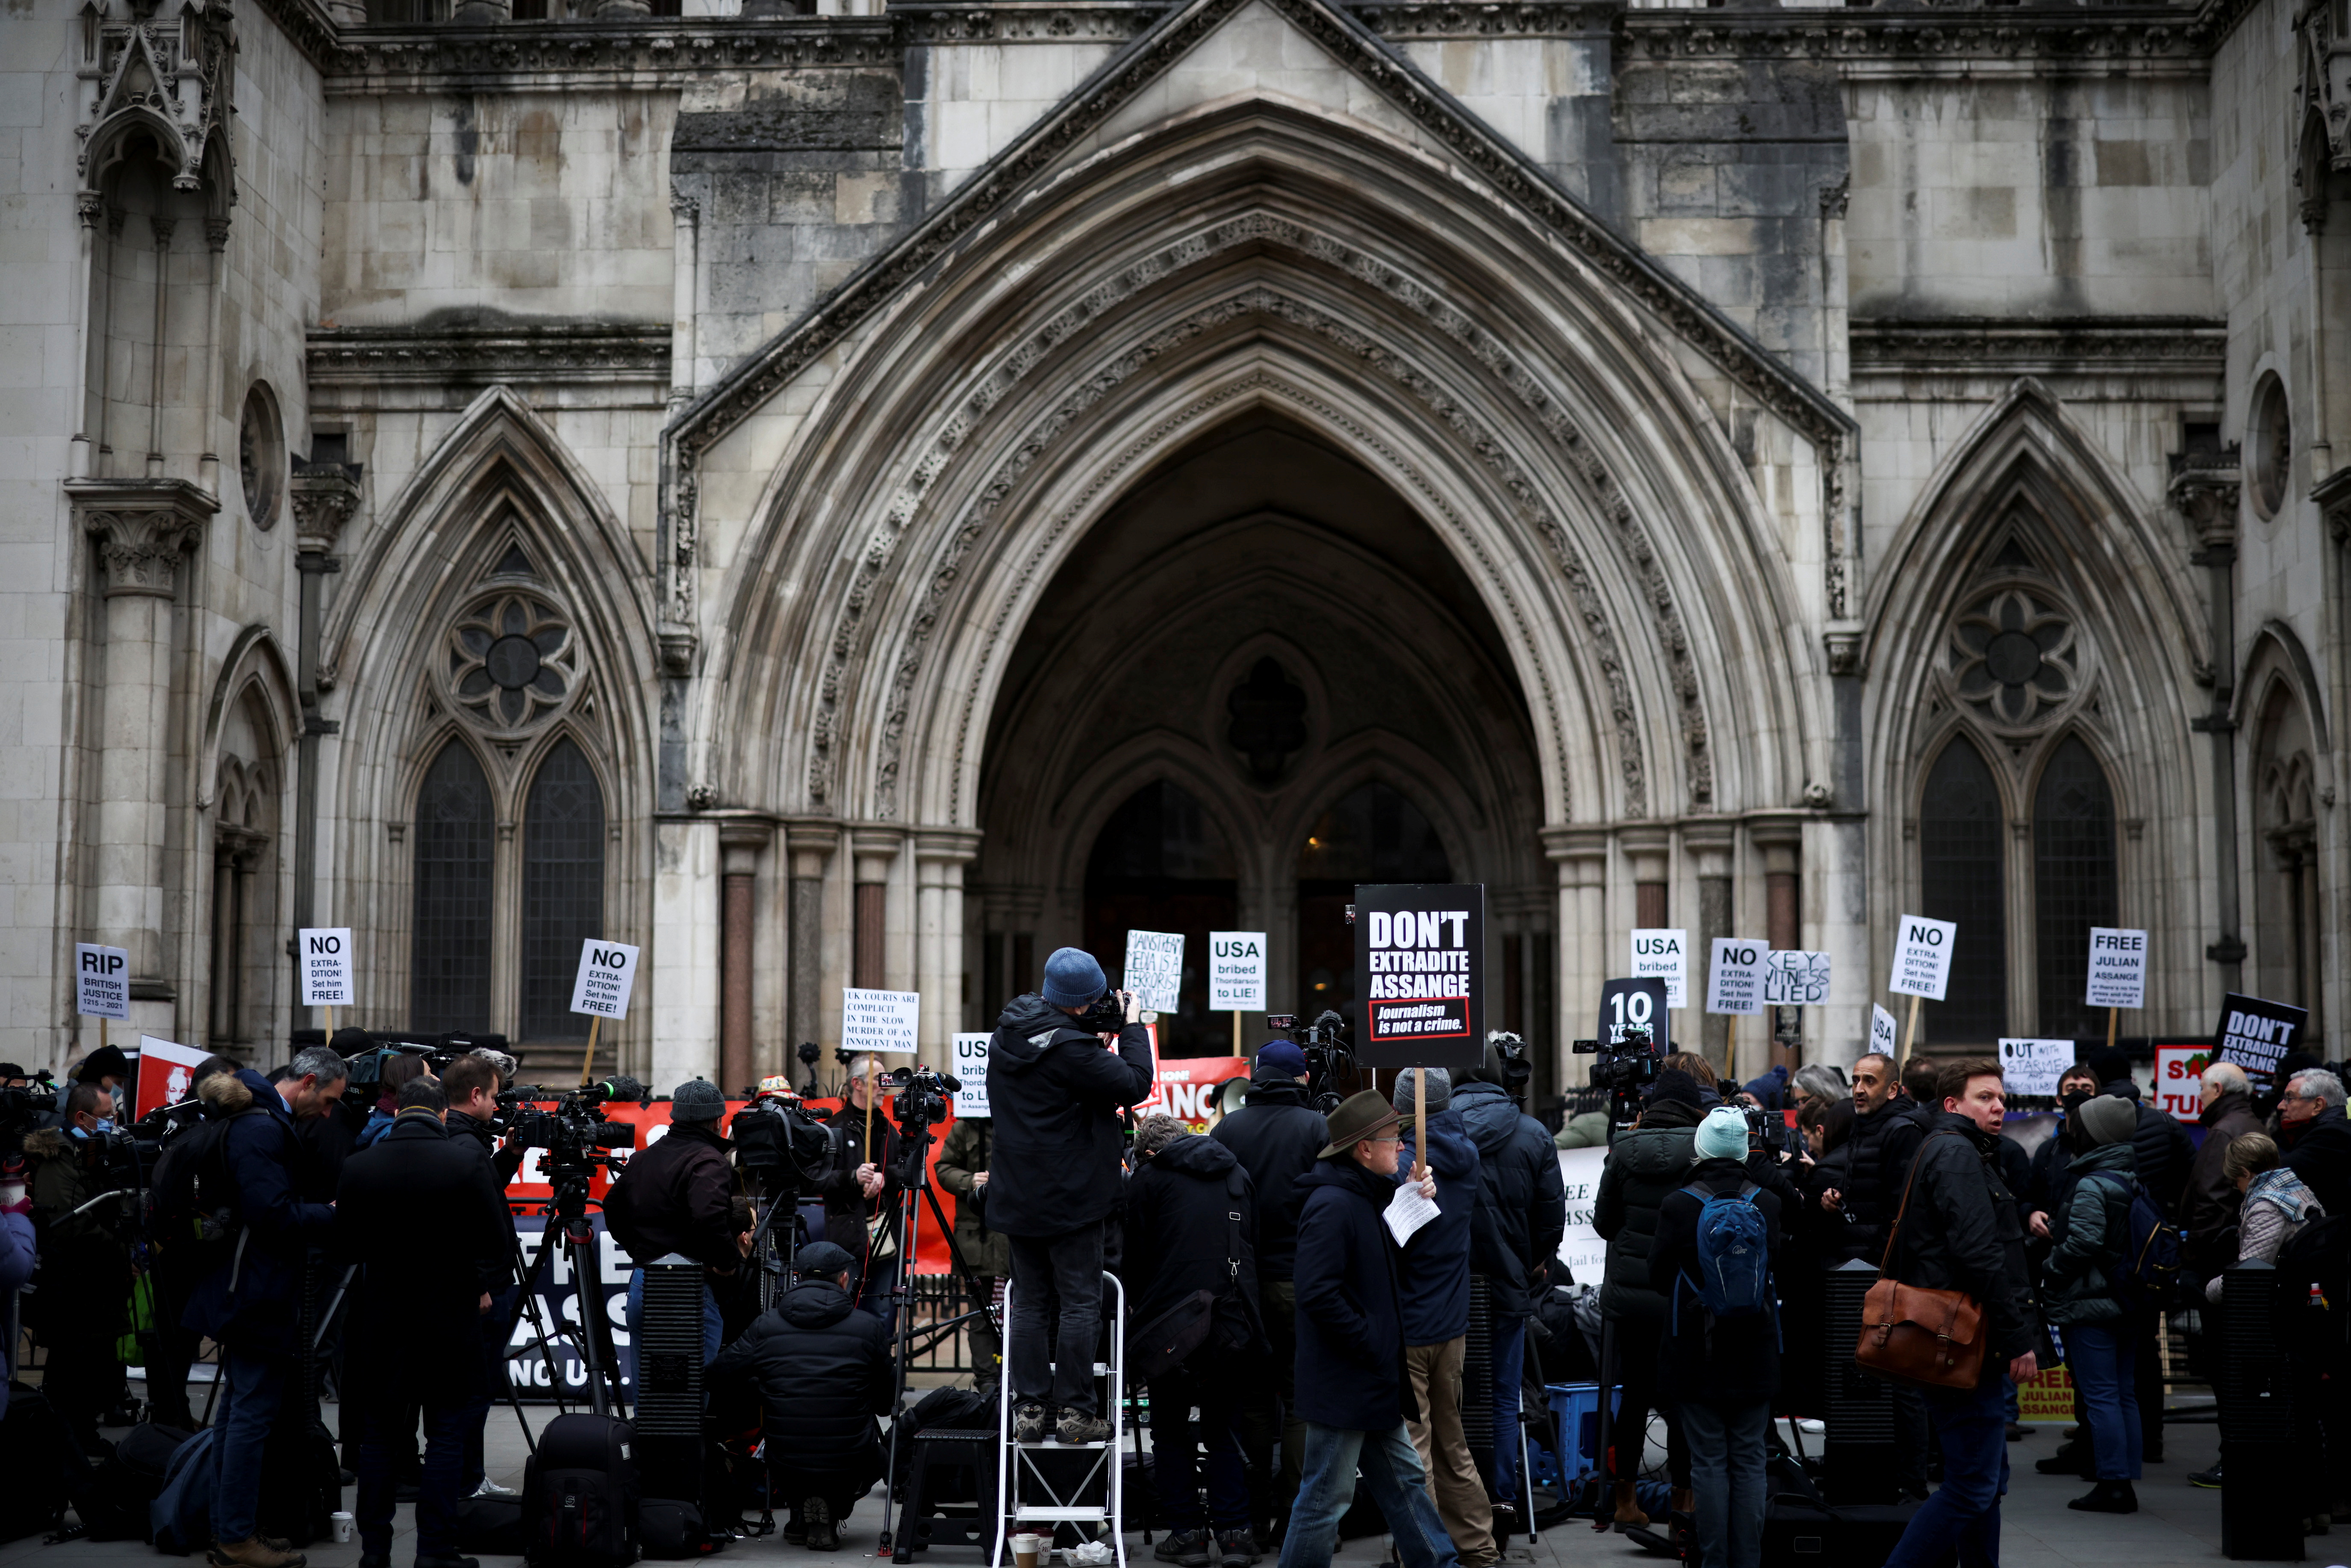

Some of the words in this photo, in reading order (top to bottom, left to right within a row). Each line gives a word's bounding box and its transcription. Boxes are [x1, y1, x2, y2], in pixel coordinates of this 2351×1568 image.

[1370, 911, 1468, 948] DON'T
[1909, 925, 1942, 946] NO
[310, 936, 340, 954] NO
[1216, 942, 1259, 957] USA
[1636, 939, 1680, 955] USA
[2096, 935, 2142, 950] FREE
[592, 948, 626, 969] NO
[1723, 947, 1756, 965] NO
[1907, 947, 1939, 959] EXTRA-
[82, 952, 124, 975] RIP
[1370, 951, 1469, 972] EXTRADITE
[1639, 962, 1677, 971] bribed
[1905, 957, 1938, 970] DITION!
[2096, 956, 2139, 967] JULIAN
[589, 970, 622, 981] EXTRA-
[1218, 964, 1256, 974] bribed
[1721, 969, 1754, 979] EXTRA-
[1903, 967, 1918, 976] Set
[1920, 971, 1936, 980] him
[2095, 971, 2139, 981] ASSANGE
[84, 978, 121, 990] BRITISH
[587, 980, 620, 991] DITION!
[1125, 970, 1181, 990] TERRORIST
[1370, 974, 1470, 998] ASSANGE
[1720, 979, 1754, 988] DITION!
[1901, 979, 1936, 993] FREE!
[83, 989, 123, 1001] JUSTICE
[312, 990, 343, 1000] FREE!
[585, 990, 599, 998] Set
[602, 992, 617, 1001] him
[865, 993, 897, 1002] COURTS
[1218, 988, 1229, 997] to
[1234, 988, 1256, 998] LIE!
[1736, 990, 1752, 998] him
[1765, 984, 1822, 1001] LIED
[582, 999, 617, 1013] FREE!
[848, 1003, 895, 1013] COMPLICIT
[1610, 991, 1653, 1024] 10
[1718, 999, 1753, 1010] FREE!
[861, 1015, 878, 1023] THE
[1377, 1005, 1445, 1020] Journalism
[847, 1026, 884, 1035] MURDER
[1378, 1021, 1390, 1034] is
[1392, 1020, 1412, 1033] not
[1414, 1020, 1423, 1032] a
[1424, 1018, 1462, 1031] crime.
[1874, 1014, 1891, 1045] USA
[2226, 1010, 2295, 1045] DON'T
[846, 1037, 890, 1047] INNOCENT
[959, 1040, 987, 1058] US
[2223, 1034, 2288, 1059] EXTRADITE
[2005, 1043, 2034, 1058] OUT
[2007, 1058, 2070, 1072] STARMER
[2219, 1048, 2277, 1073] ASSANG
[963, 1065, 986, 1075] brib
[962, 1091, 973, 1100] to
[1564, 1184, 1589, 1200] EE
[1569, 1254, 1588, 1269] Jail
[509, 1359, 557, 1387] NO
[2027, 1370, 2072, 1388] REE
[2022, 1391, 2071, 1401] JULIAN
